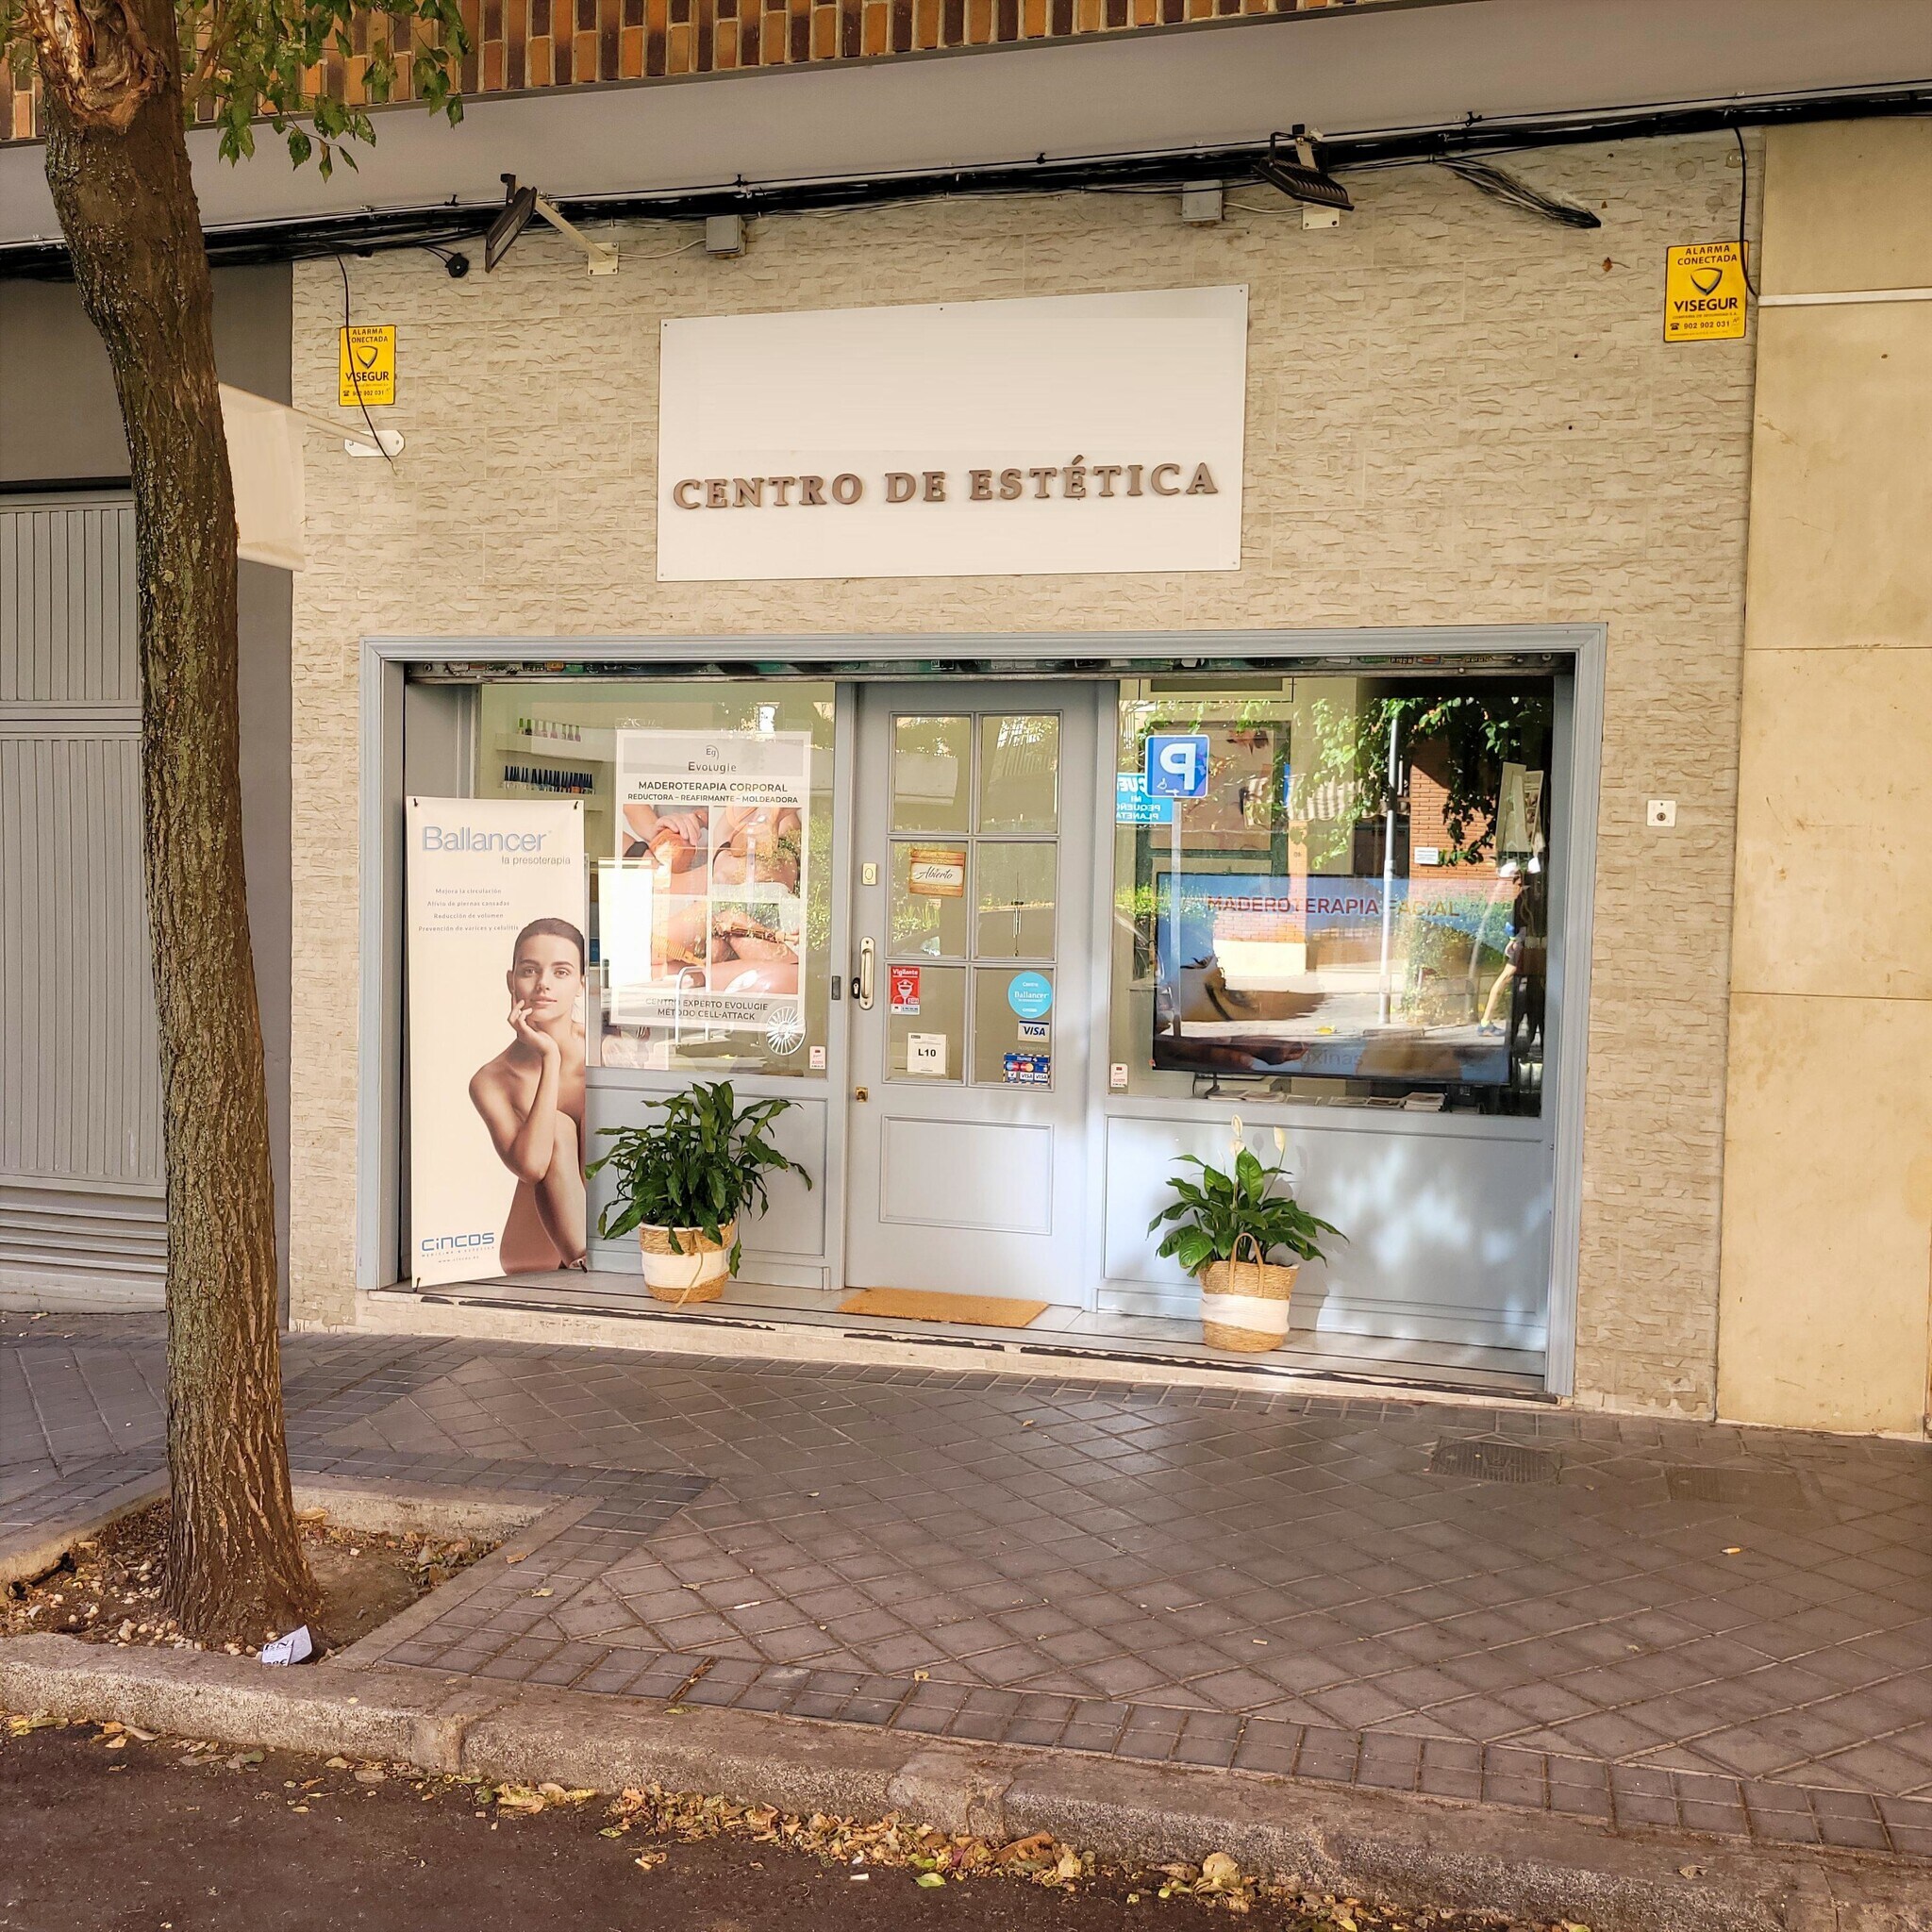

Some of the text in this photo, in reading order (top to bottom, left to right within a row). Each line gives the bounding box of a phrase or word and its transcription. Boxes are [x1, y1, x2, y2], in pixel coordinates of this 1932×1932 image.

[1686, 245, 1730, 256] ALARMA
[1677, 254, 1738, 265] CONECTADA
[1674, 297, 1738, 312] VISEGUR
[345, 372, 390, 382] VSEGUR
[673, 454, 1219, 509] CENTRO DE ESTÉTICA
[688, 761, 737, 774] Evolugie
[639, 781, 788, 792] MADEROTERAPIA CORPORAL
[422, 825, 548, 853] Ballancer
[501, 855, 571, 866] la presoterapia
[915, 865, 953, 879] Abierto
[1208, 896, 1379, 914] MADEROTERAPIA
[683, 999, 723, 1008] EXPERTO
[724, 1001, 769, 1010] EVOLUGIE
[697, 1010, 756, 1020] CELL-ATTACK
[1023, 1025, 1046, 1037] VISA
[918, 1048, 937, 1057] L10
